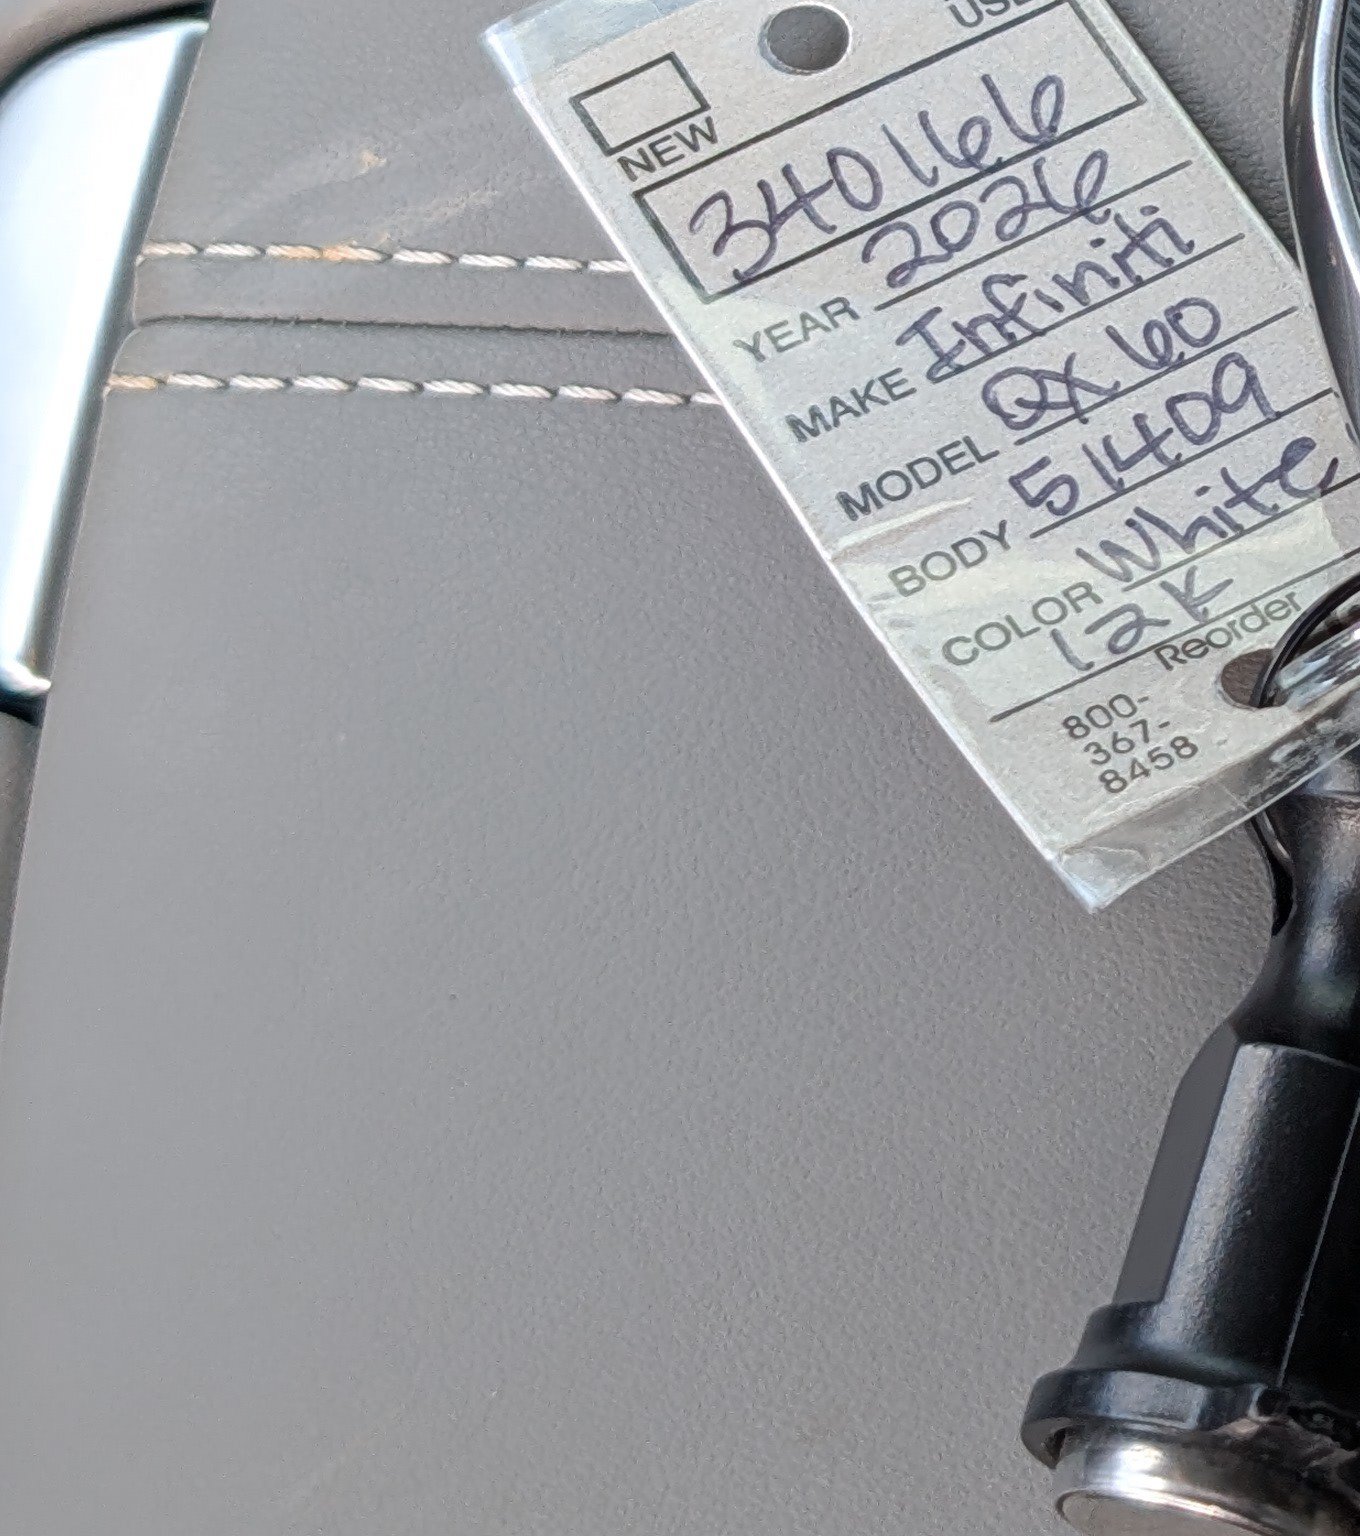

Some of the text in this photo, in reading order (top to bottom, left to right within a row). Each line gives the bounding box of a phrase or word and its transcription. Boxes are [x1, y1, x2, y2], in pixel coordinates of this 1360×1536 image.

[616, 115, 720, 182] NEW
[689, 74, 1065, 284] 340166
[862, 149, 1110, 289] 2026
[734, 295, 861, 364] YEAR
[897, 205, 1195, 382] Infiniti
[786, 368, 916, 442] MAKE
[1008, 352, 1280, 517] 51409
[836, 434, 1000, 521] MODEL
[1076, 435, 1339, 582] White
[887, 520, 1013, 598] BODY
[941, 581, 1103, 666] COLOR
[1154, 591, 1302, 672] Reorder
[1062, 693, 1149, 739] 800-
[1083, 717, 1170, 766] 367-
[1099, 735, 1198, 794] 8458
